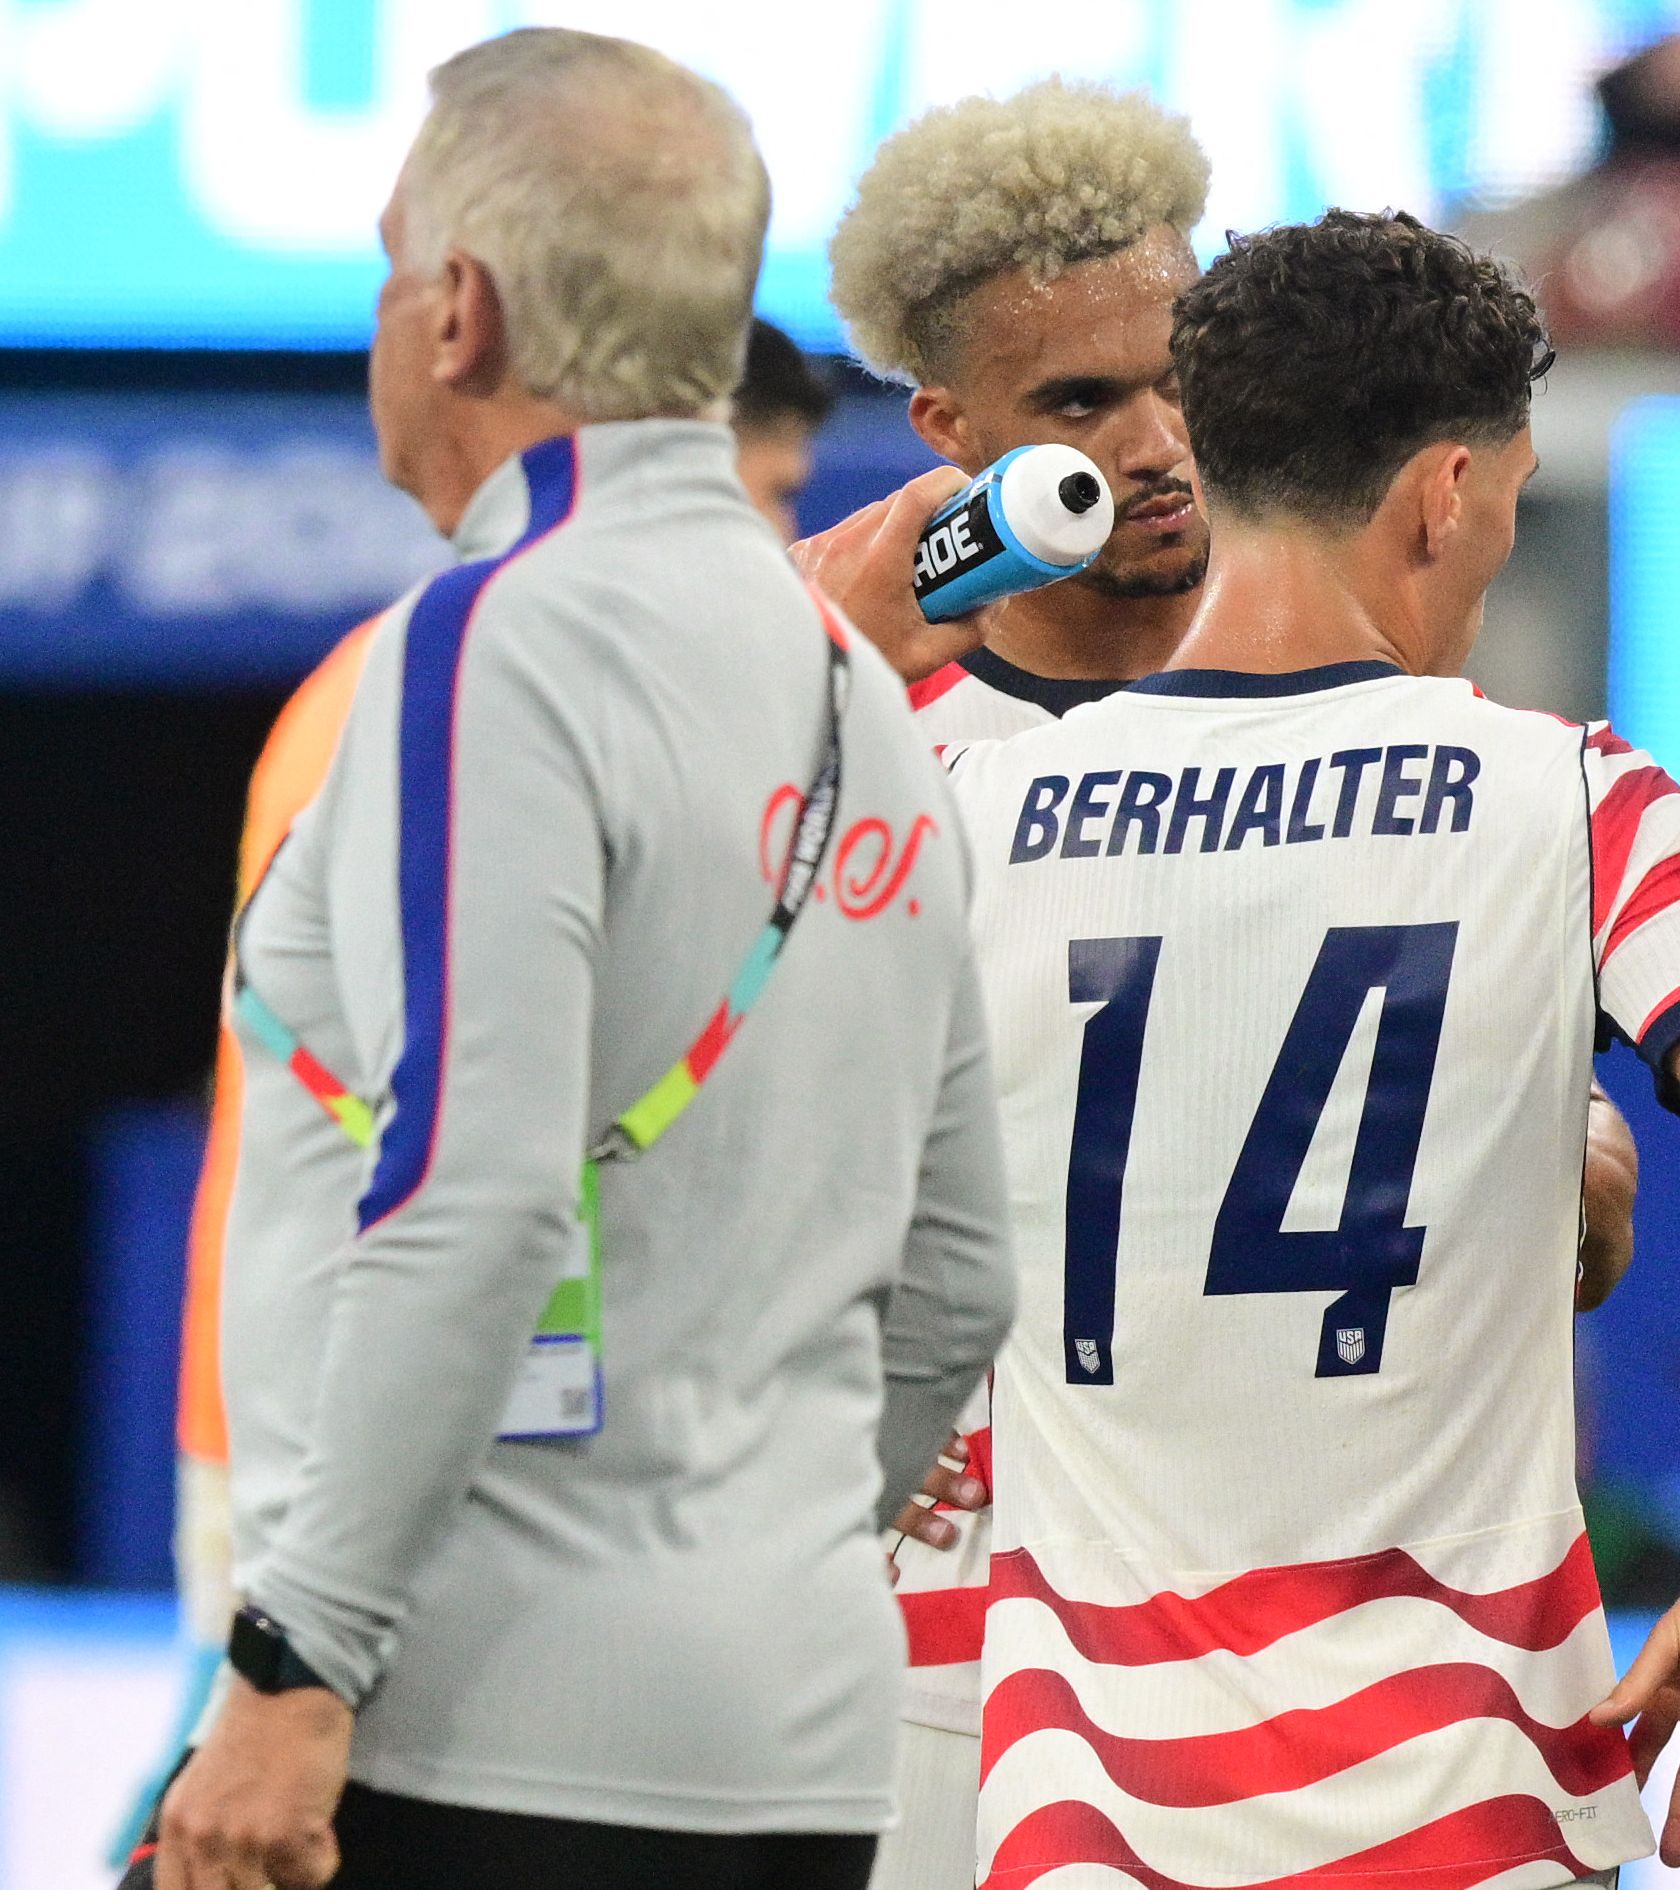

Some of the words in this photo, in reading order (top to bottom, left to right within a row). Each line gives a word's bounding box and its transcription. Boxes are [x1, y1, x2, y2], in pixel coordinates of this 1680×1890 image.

[1008, 744, 1482, 866] BERHALTER
[1063, 920, 1461, 1386] 14
[1338, 1330, 1362, 1345] USA
